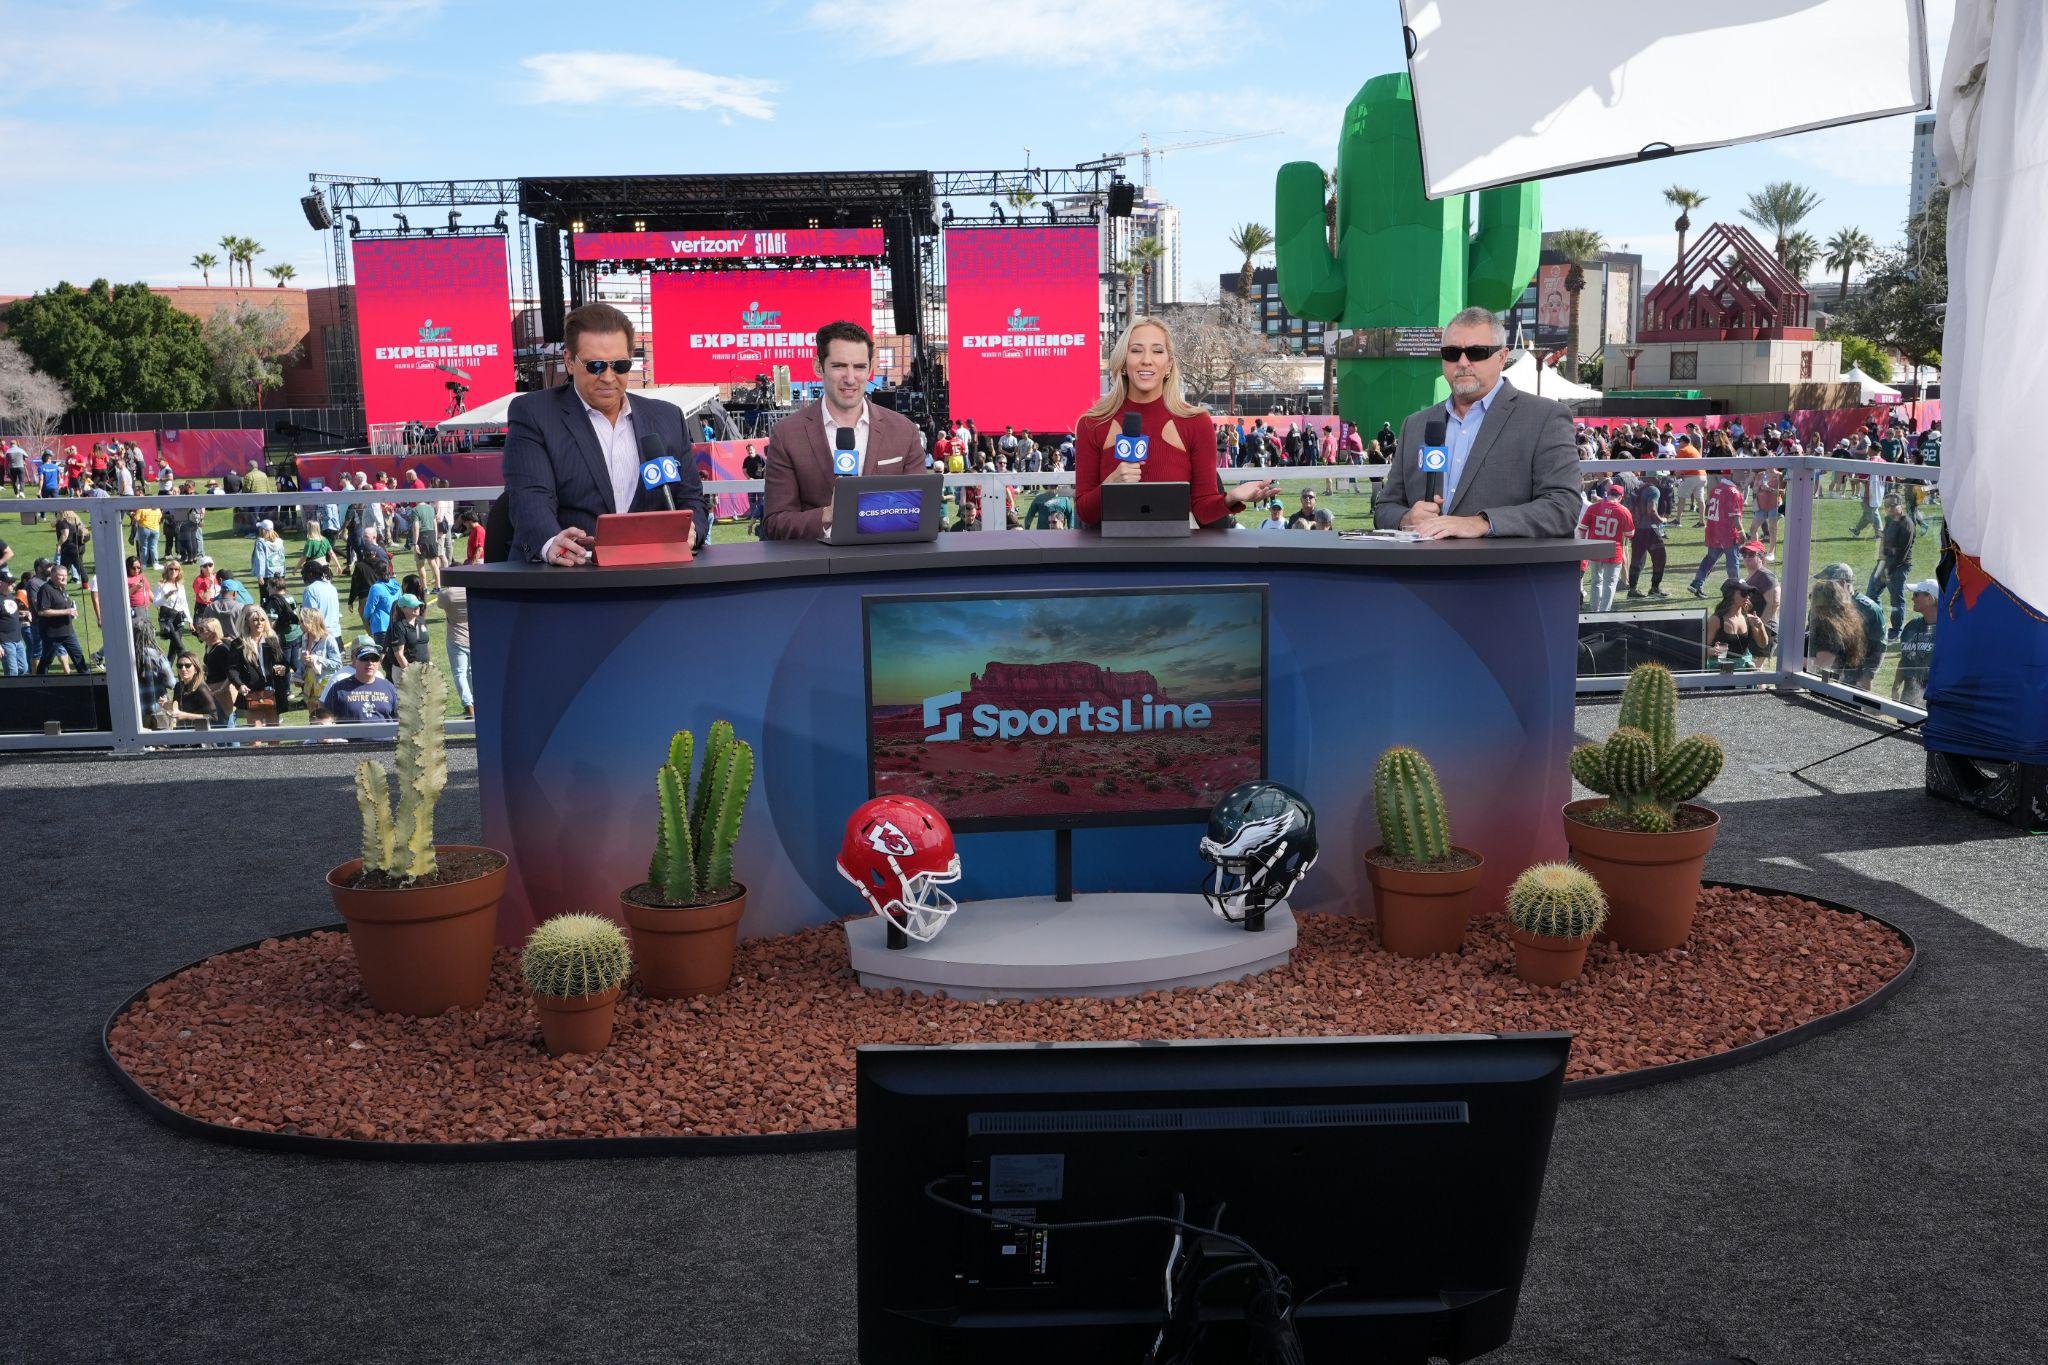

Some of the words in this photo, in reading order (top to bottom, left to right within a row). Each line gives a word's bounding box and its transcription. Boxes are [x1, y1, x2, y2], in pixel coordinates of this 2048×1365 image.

[671, 236, 739, 253] verizon
[755, 233, 787, 254] STAGE
[690, 332, 817, 348] EXPERIENC
[963, 334, 1085, 348] EXPERIENCE
[375, 344, 498, 360] EXPERIENCE
[764, 349, 771, 358] AT
[865, 509, 879, 517] CBS
[1708, 497, 1720, 522] 21
[1594, 515, 1619, 538] 50
[347, 694, 369, 702] NOTRE
[371, 694, 389, 702] DAME
[972, 693, 1213, 740] SportsLine
